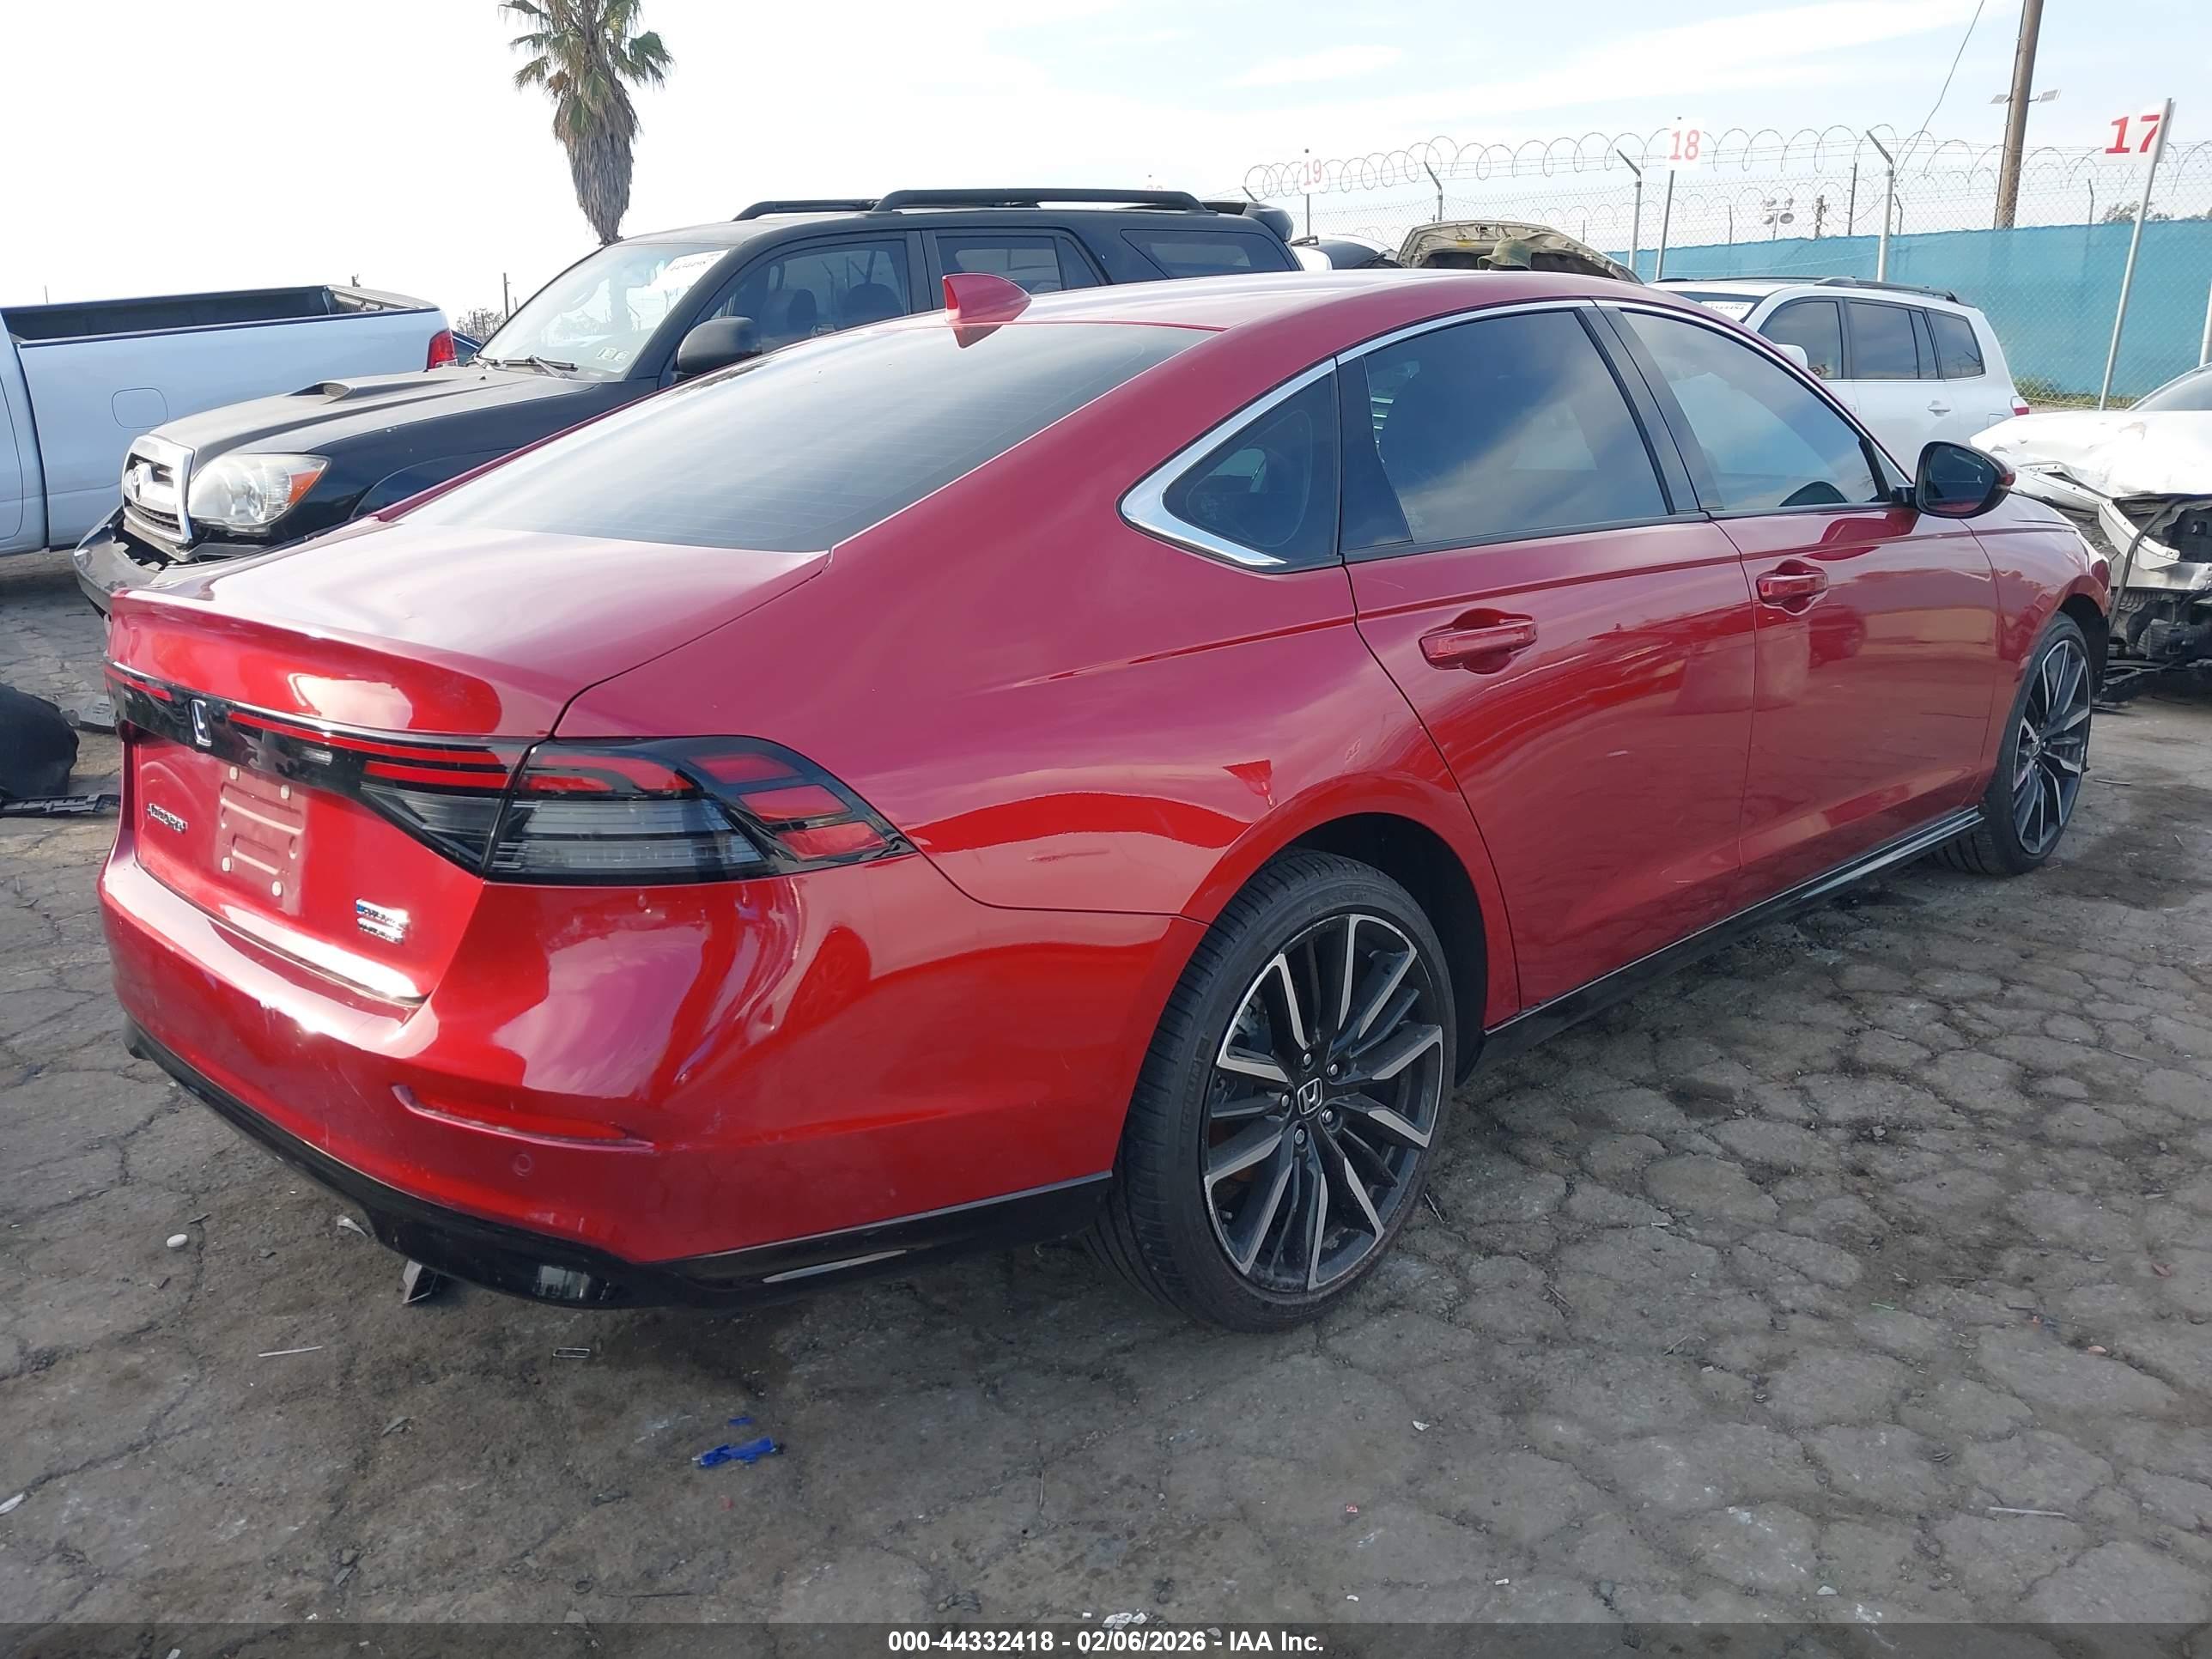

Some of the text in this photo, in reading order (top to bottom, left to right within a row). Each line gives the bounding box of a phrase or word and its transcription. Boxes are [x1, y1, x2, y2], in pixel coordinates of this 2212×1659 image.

[1669, 130, 1700, 161] 18
[2106, 114, 2160, 154] 17
[1304, 159, 1322, 185] 19
